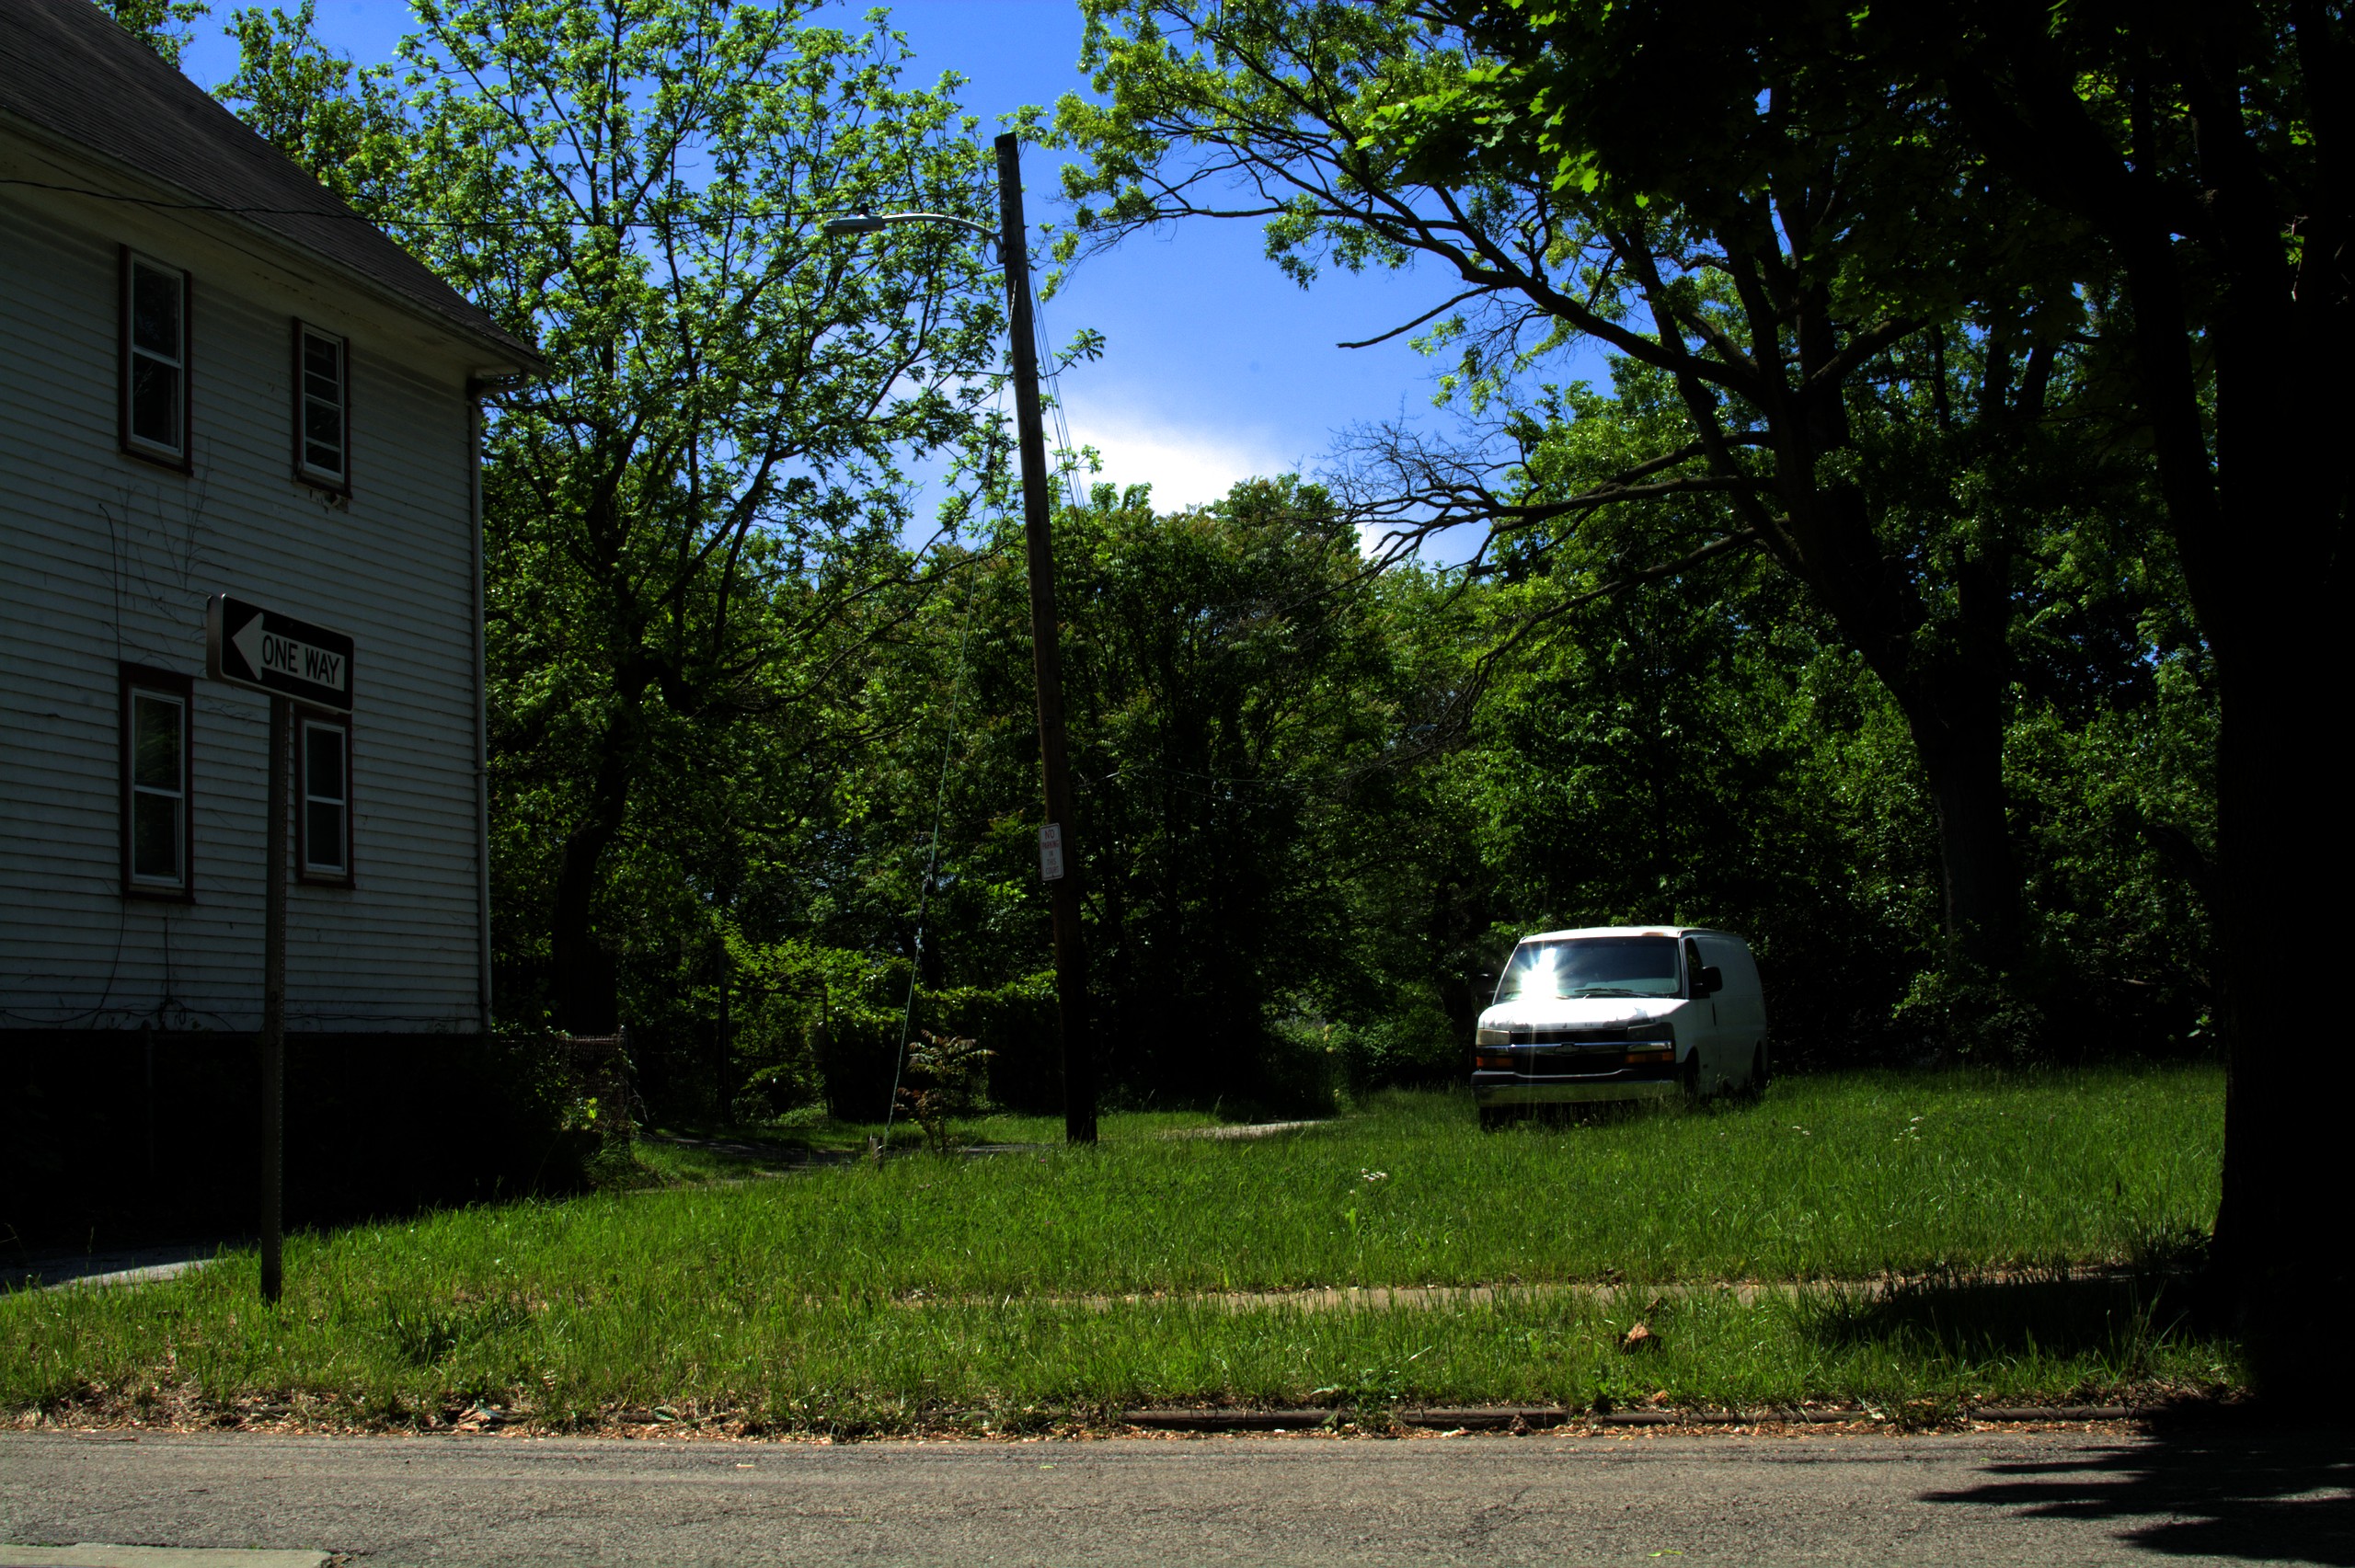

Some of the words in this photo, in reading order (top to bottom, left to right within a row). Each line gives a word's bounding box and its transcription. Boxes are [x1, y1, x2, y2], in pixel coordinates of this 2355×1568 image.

[262, 635, 298, 673] ONE
[305, 647, 340, 685] WAY
[1044, 829, 1054, 839] NO
[1042, 840, 1060, 849] PARKING
